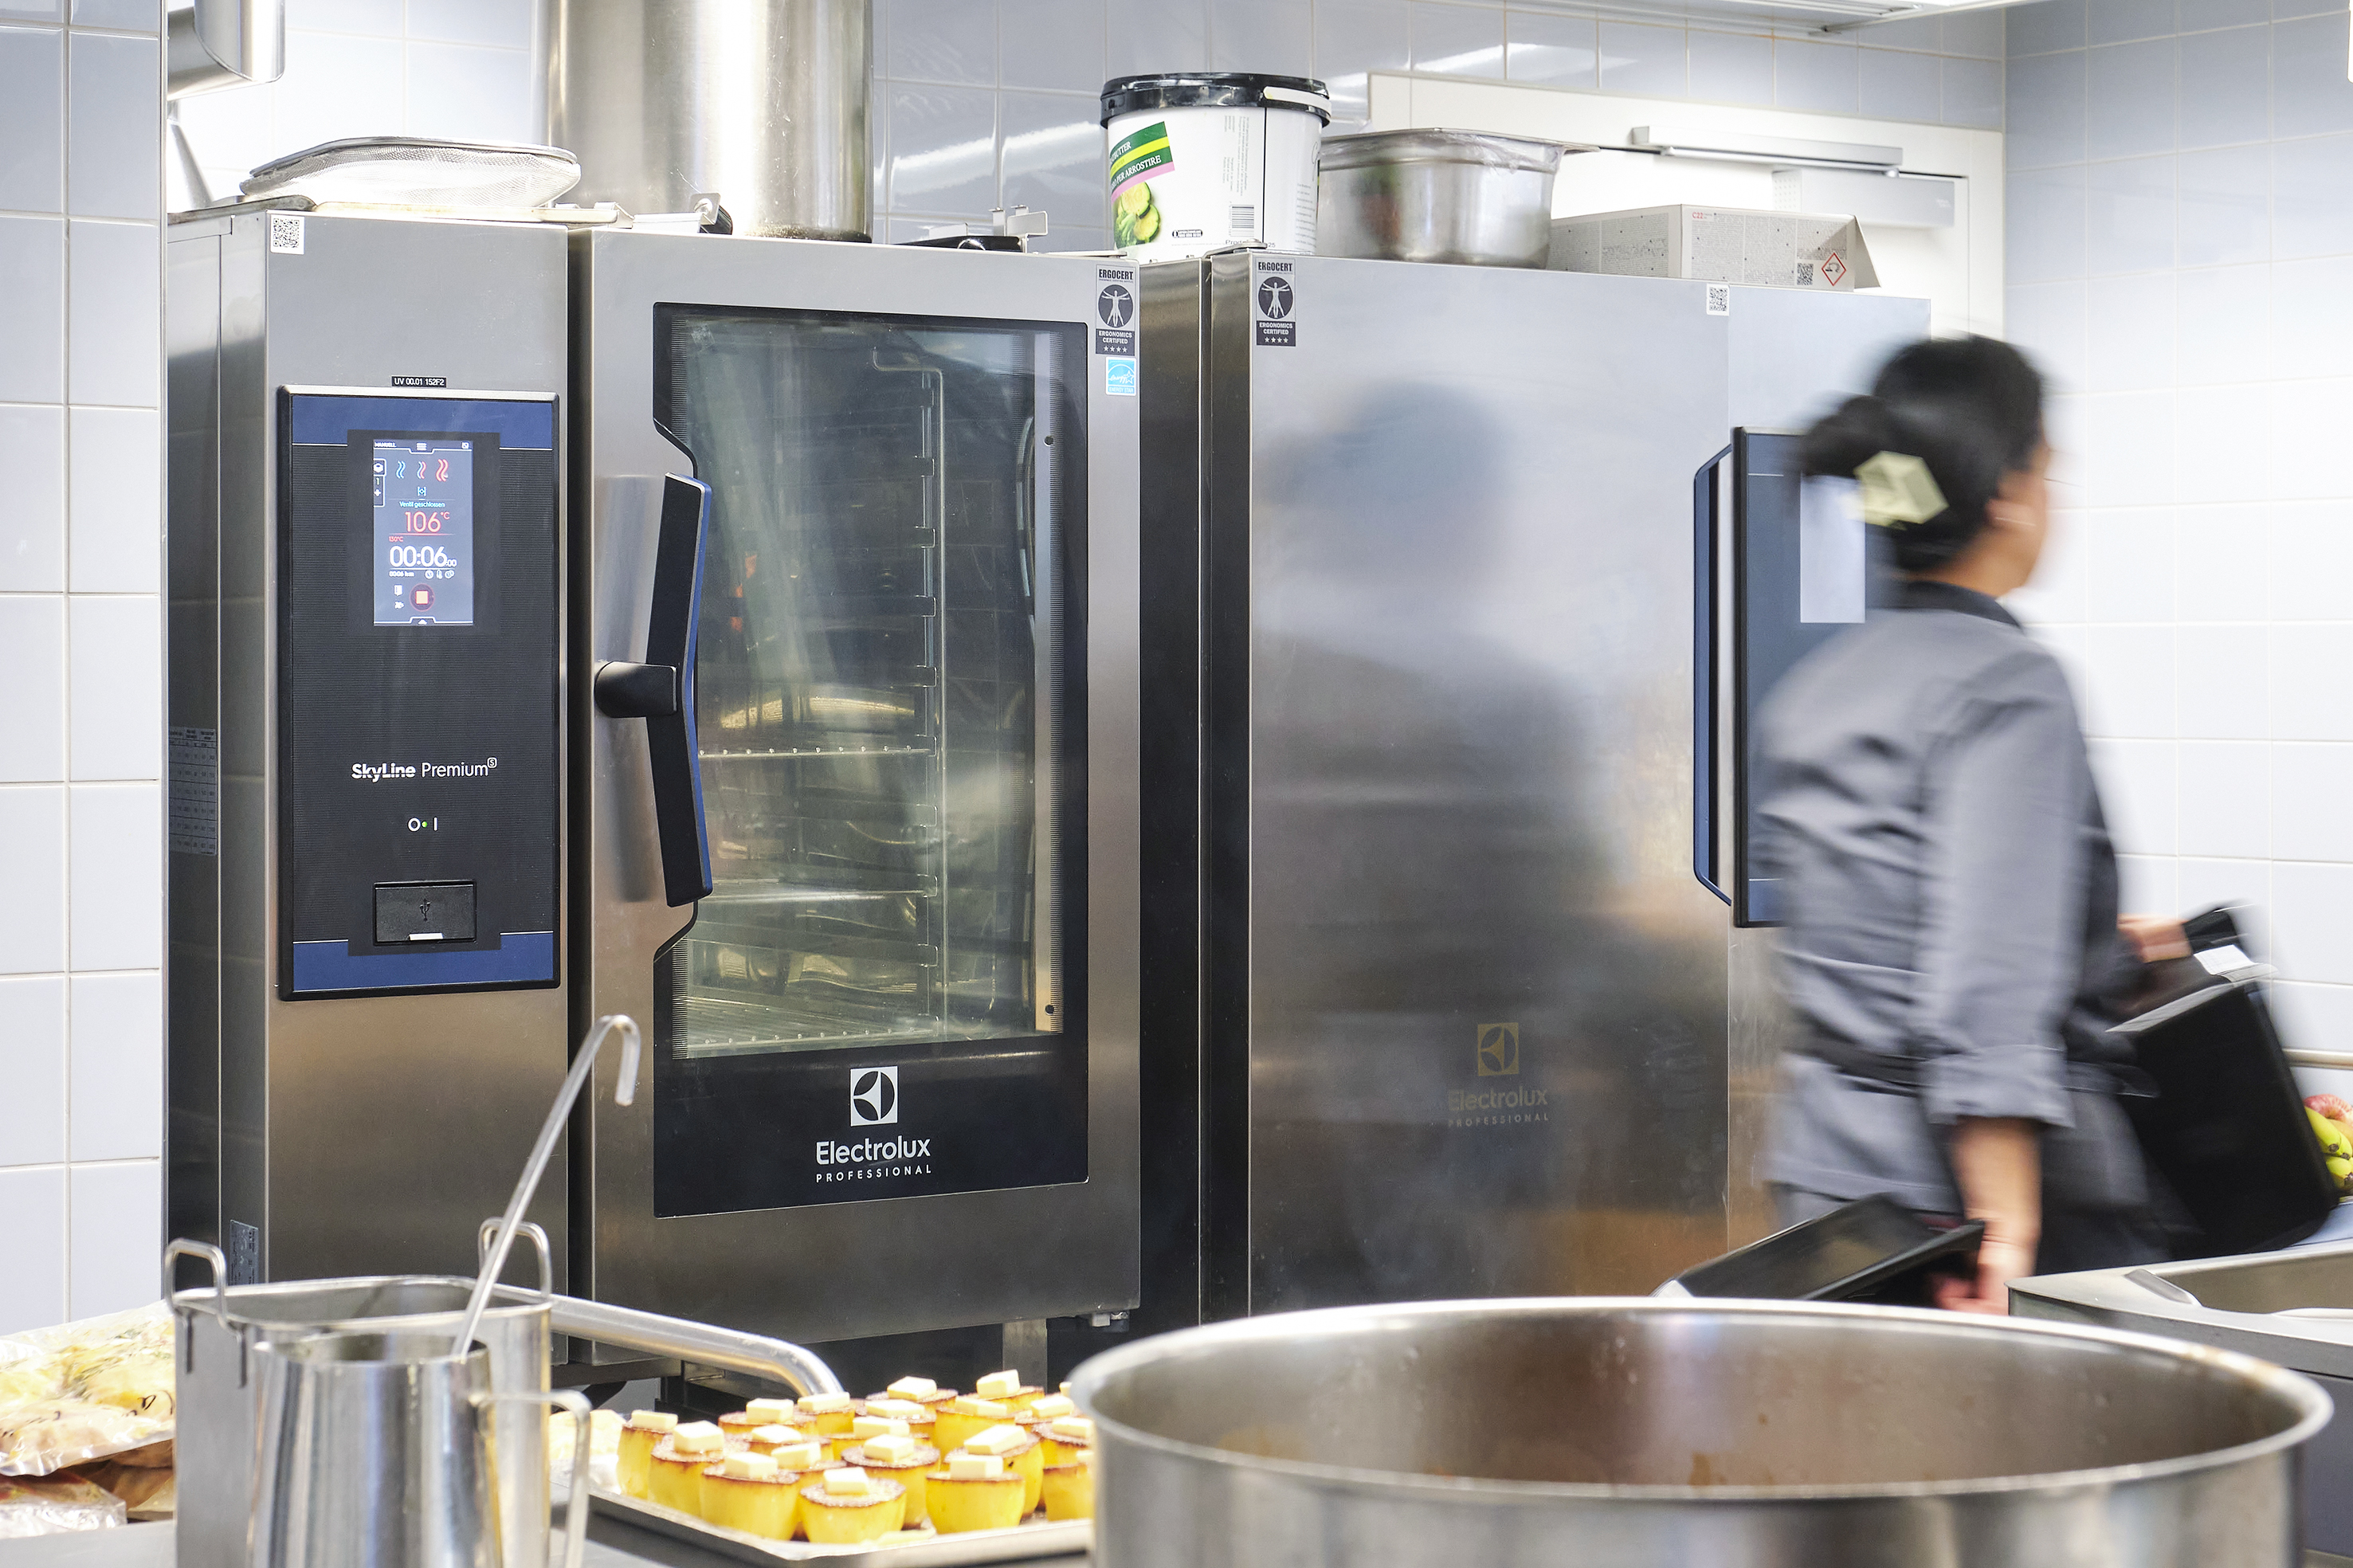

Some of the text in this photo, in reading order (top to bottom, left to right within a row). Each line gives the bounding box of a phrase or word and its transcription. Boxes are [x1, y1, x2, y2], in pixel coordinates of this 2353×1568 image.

[1116, 171, 1126, 184] PER
[1125, 155, 1162, 178] ARROSTIRE
[1099, 269, 1134, 280] ERGOCERT
[1258, 261, 1293, 272] ERGOCERT
[1098, 330, 1132, 339] ERGONOMICS
[394, 377, 405, 386] UV
[406, 377, 423, 386] 00.01
[351, 762, 417, 783] SkyLine
[1448, 1085, 1548, 1111] Electrolux
[1448, 1112, 1549, 1128] PROFESSIONAL
[816, 1135, 931, 1166] Electrolux
[816, 1163, 931, 1183] PROFESSIONAL
